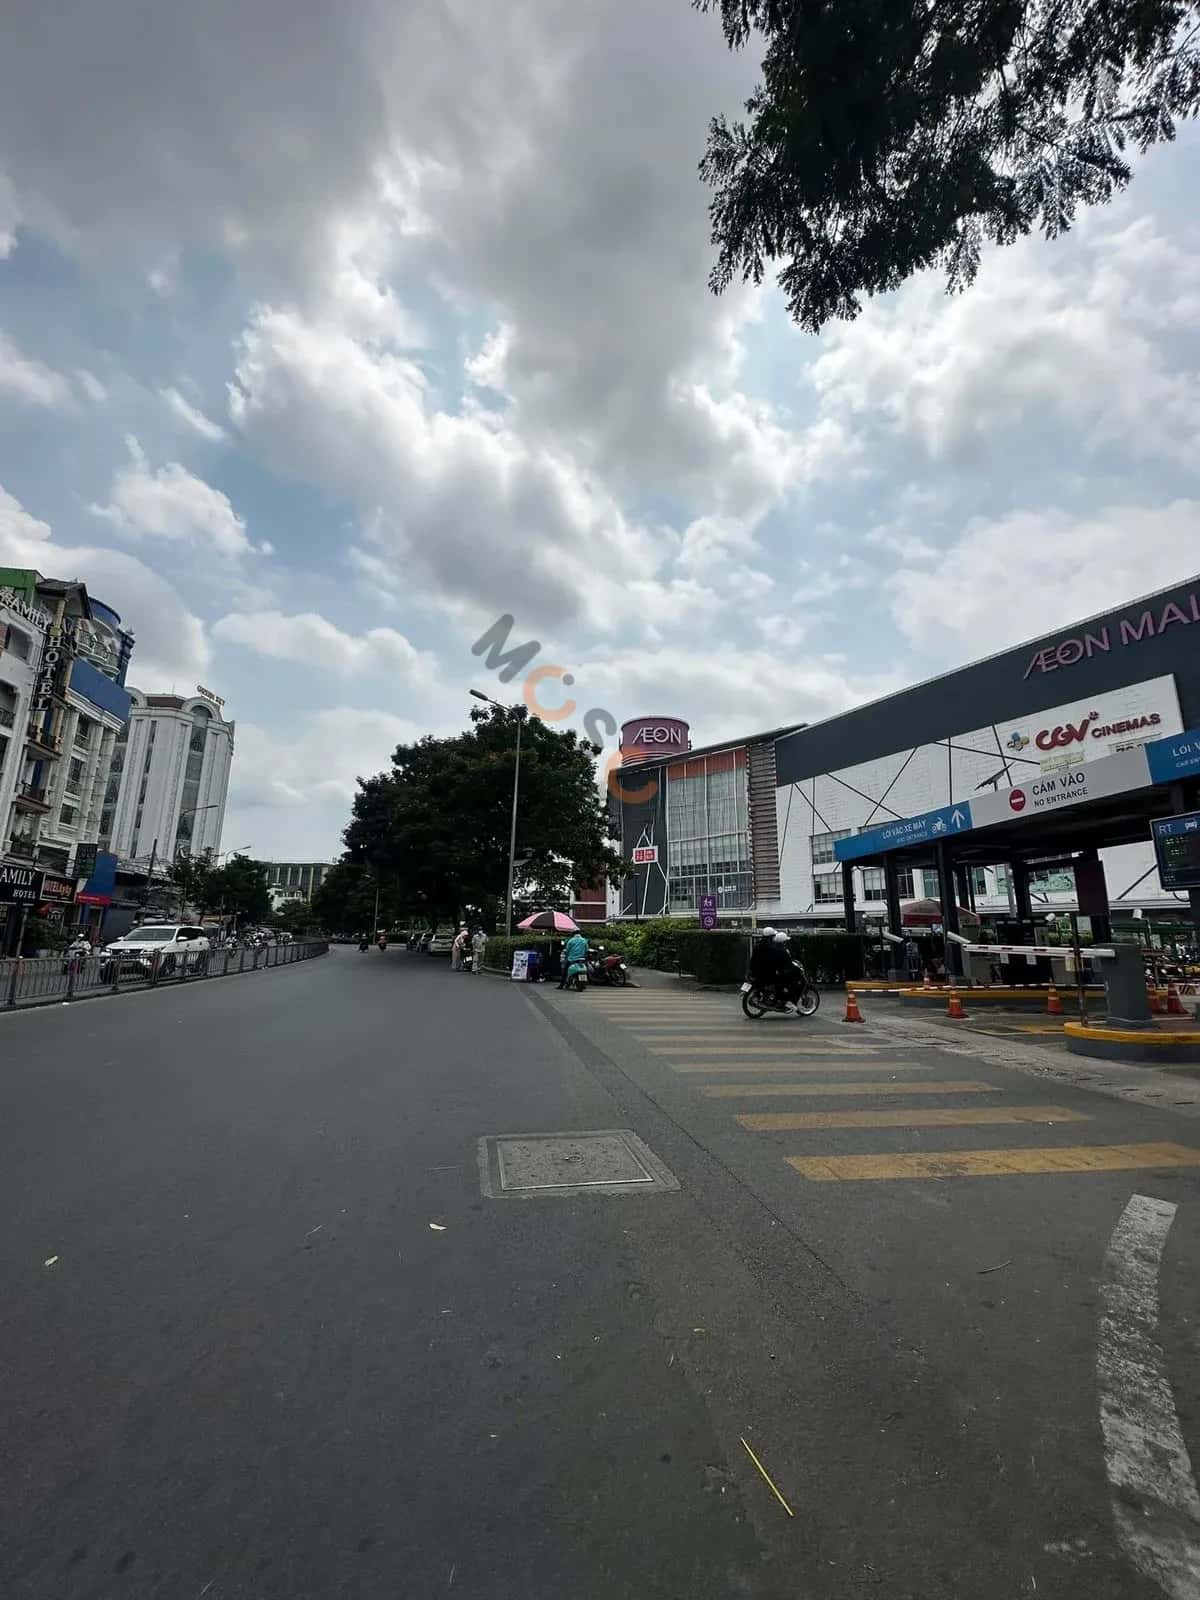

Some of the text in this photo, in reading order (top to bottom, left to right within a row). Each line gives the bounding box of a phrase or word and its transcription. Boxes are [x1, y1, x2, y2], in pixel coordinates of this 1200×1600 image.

[38, 635, 61, 710] HOTEL
[1035, 719, 1090, 750] CGV
[1091, 713, 1161, 739] CINEMAS
[1060, 772, 1085, 787] VÀO
[1034, 787, 1088, 808] NO ENTRANCE
